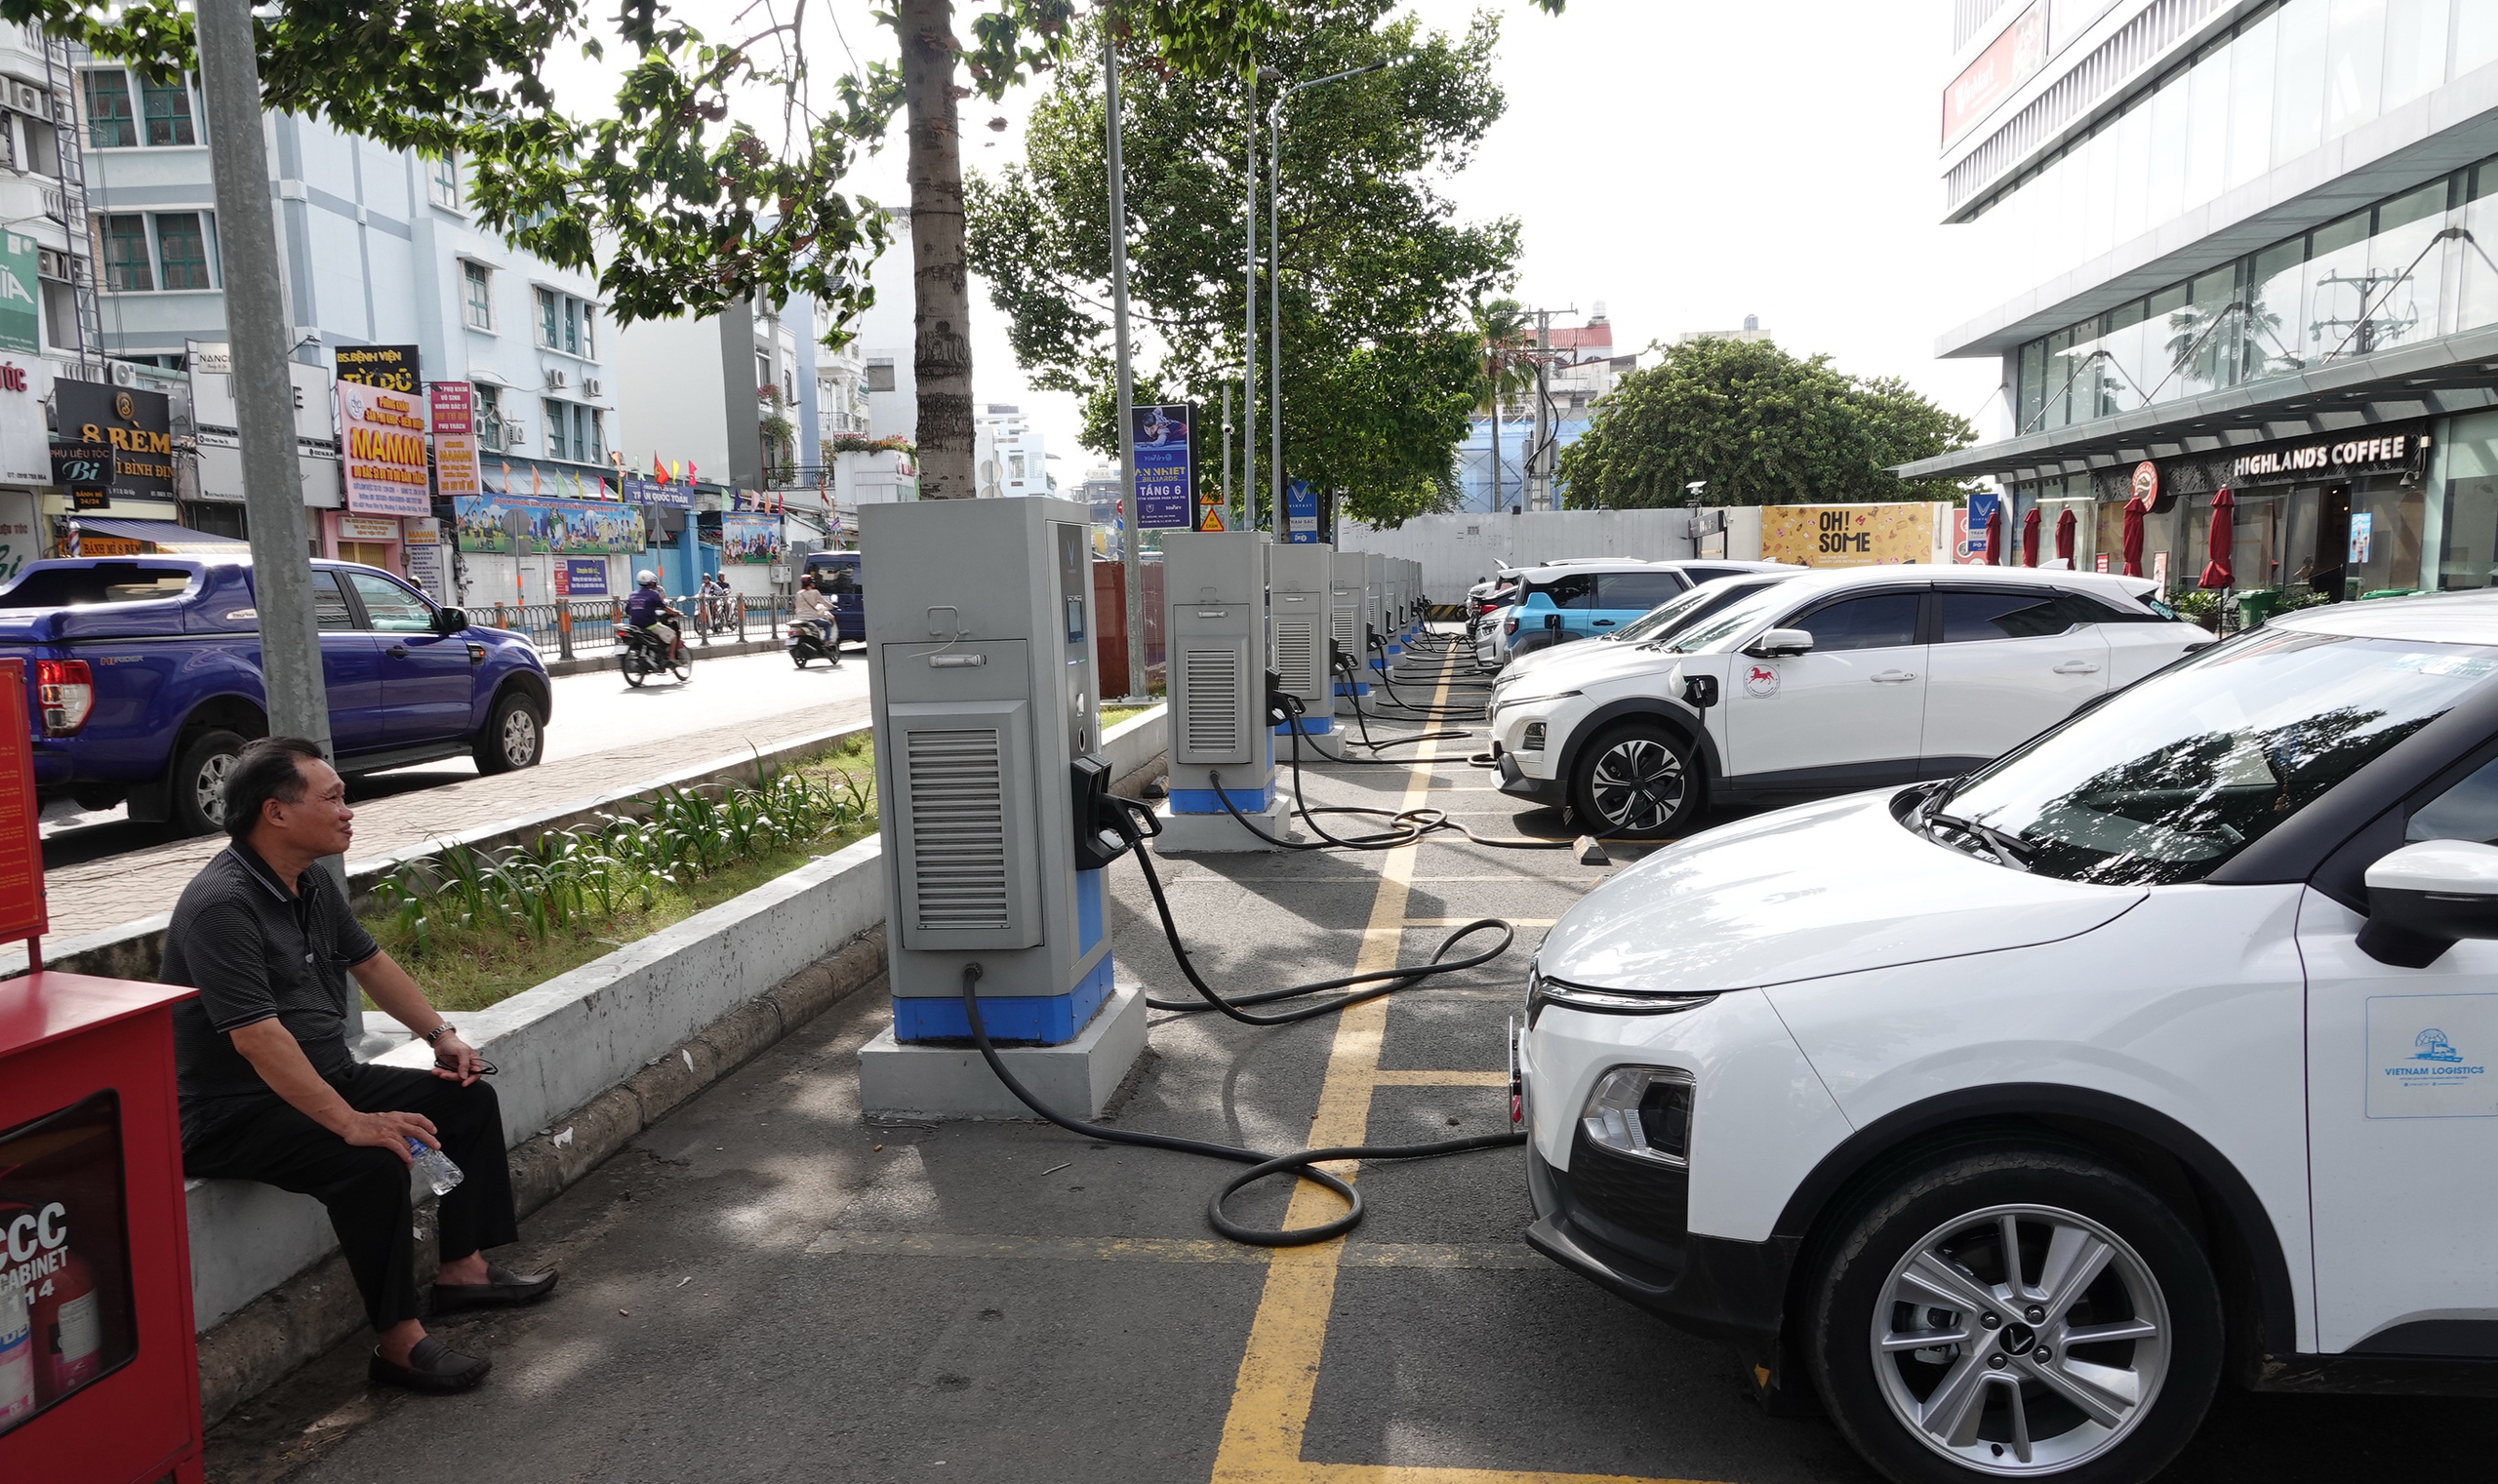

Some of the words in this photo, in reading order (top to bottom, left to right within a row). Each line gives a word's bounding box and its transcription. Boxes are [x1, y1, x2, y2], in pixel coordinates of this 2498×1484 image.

[106, 421, 172, 455] RÈM
[350, 426, 426, 466] MAMMI
[2234, 446, 2328, 476] HIGHLANDS
[2331, 435, 2405, 463] COFFEE
[62, 461, 101, 481] Bi
[124, 459, 152, 476] BÌNH
[1174, 485, 1182, 495] 6
[1819, 510, 1850, 532] OH!
[1819, 532, 1871, 553] SOME
[2150, 601, 2174, 621] Grab
[2385, 1066, 2429, 1076] VIETNAM
[2432, 1065, 2485, 1075] LOGISTICS
[0, 1245, 69, 1296] CABINET
